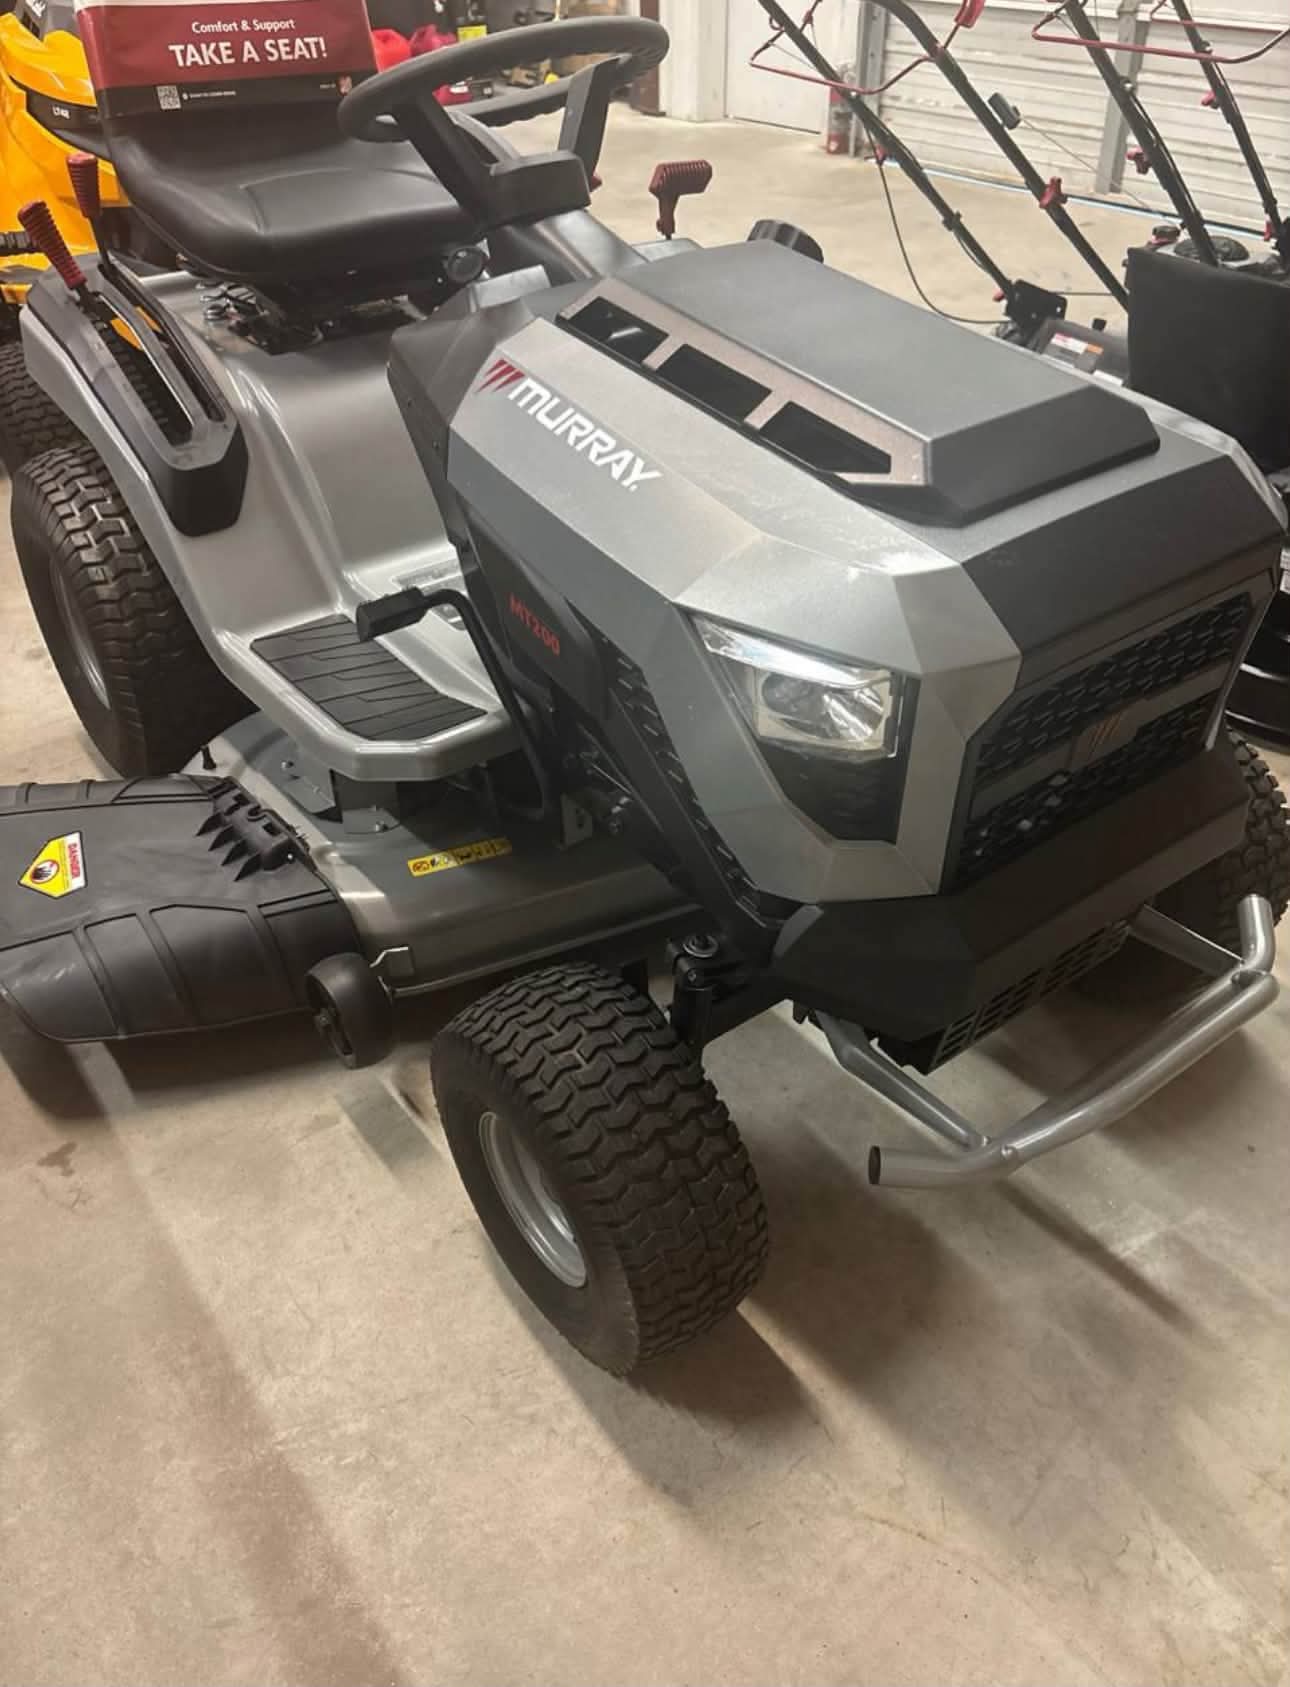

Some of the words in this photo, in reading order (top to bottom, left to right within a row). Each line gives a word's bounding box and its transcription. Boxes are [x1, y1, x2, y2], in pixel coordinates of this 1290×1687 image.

[191, 20, 238, 34] Comfort
[241, 19, 250, 31] &
[253, 18, 296, 33] Support
[168, 41, 235, 67] TAKE
[242, 40, 261, 63] A
[264, 36, 327, 62] SEAT!
[509, 593, 560, 656] MT200
[68, 843, 80, 879] DANGER
